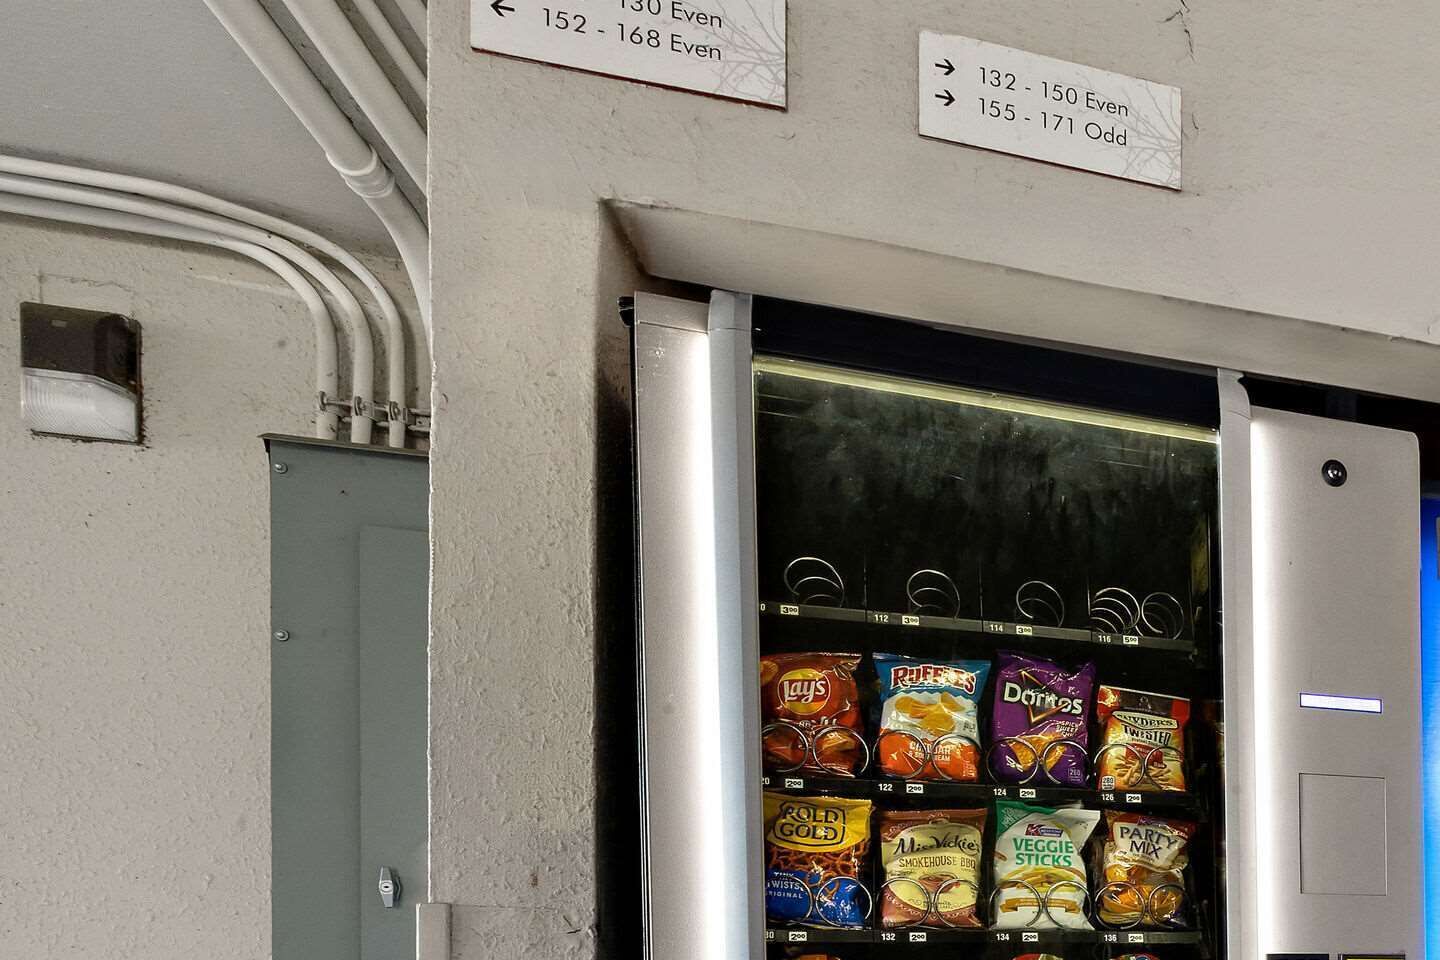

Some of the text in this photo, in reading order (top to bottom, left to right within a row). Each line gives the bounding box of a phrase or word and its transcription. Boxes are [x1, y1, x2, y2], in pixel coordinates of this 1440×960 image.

[671, 1, 722, 28] Even
[543, 8, 587, 34] 152
[617, 23, 661, 48] 168
[670, 33, 722, 61] Even
[979, 66, 1016, 91] 132
[1042, 81, 1078, 105] 150
[1086, 92, 1129, 117] Even
[978, 97, 1016, 121] 155
[1041, 111, 1073, 134] 171
[1085, 122, 1127, 146] Odd
[874, 614, 889, 623] 112
[990, 624, 1003, 632] 114
[1098, 635, 1111, 643] 116
[783, 678, 828, 704] Lay's
[1003, 681, 1083, 716] Doritos
[993, 788, 1007, 796] 124
[780, 823, 838, 841] GOLD
[1120, 826, 1178, 850] PARTY
[1013, 837, 1073, 854] VEGGIE
[1130, 839, 1163, 861] MIX
[899, 855, 976, 870] SMOKEHOUSE BBQ
[1015, 852, 1072, 867] STICKS
[881, 933, 896, 941] 132
[996, 933, 1009, 941] 134
